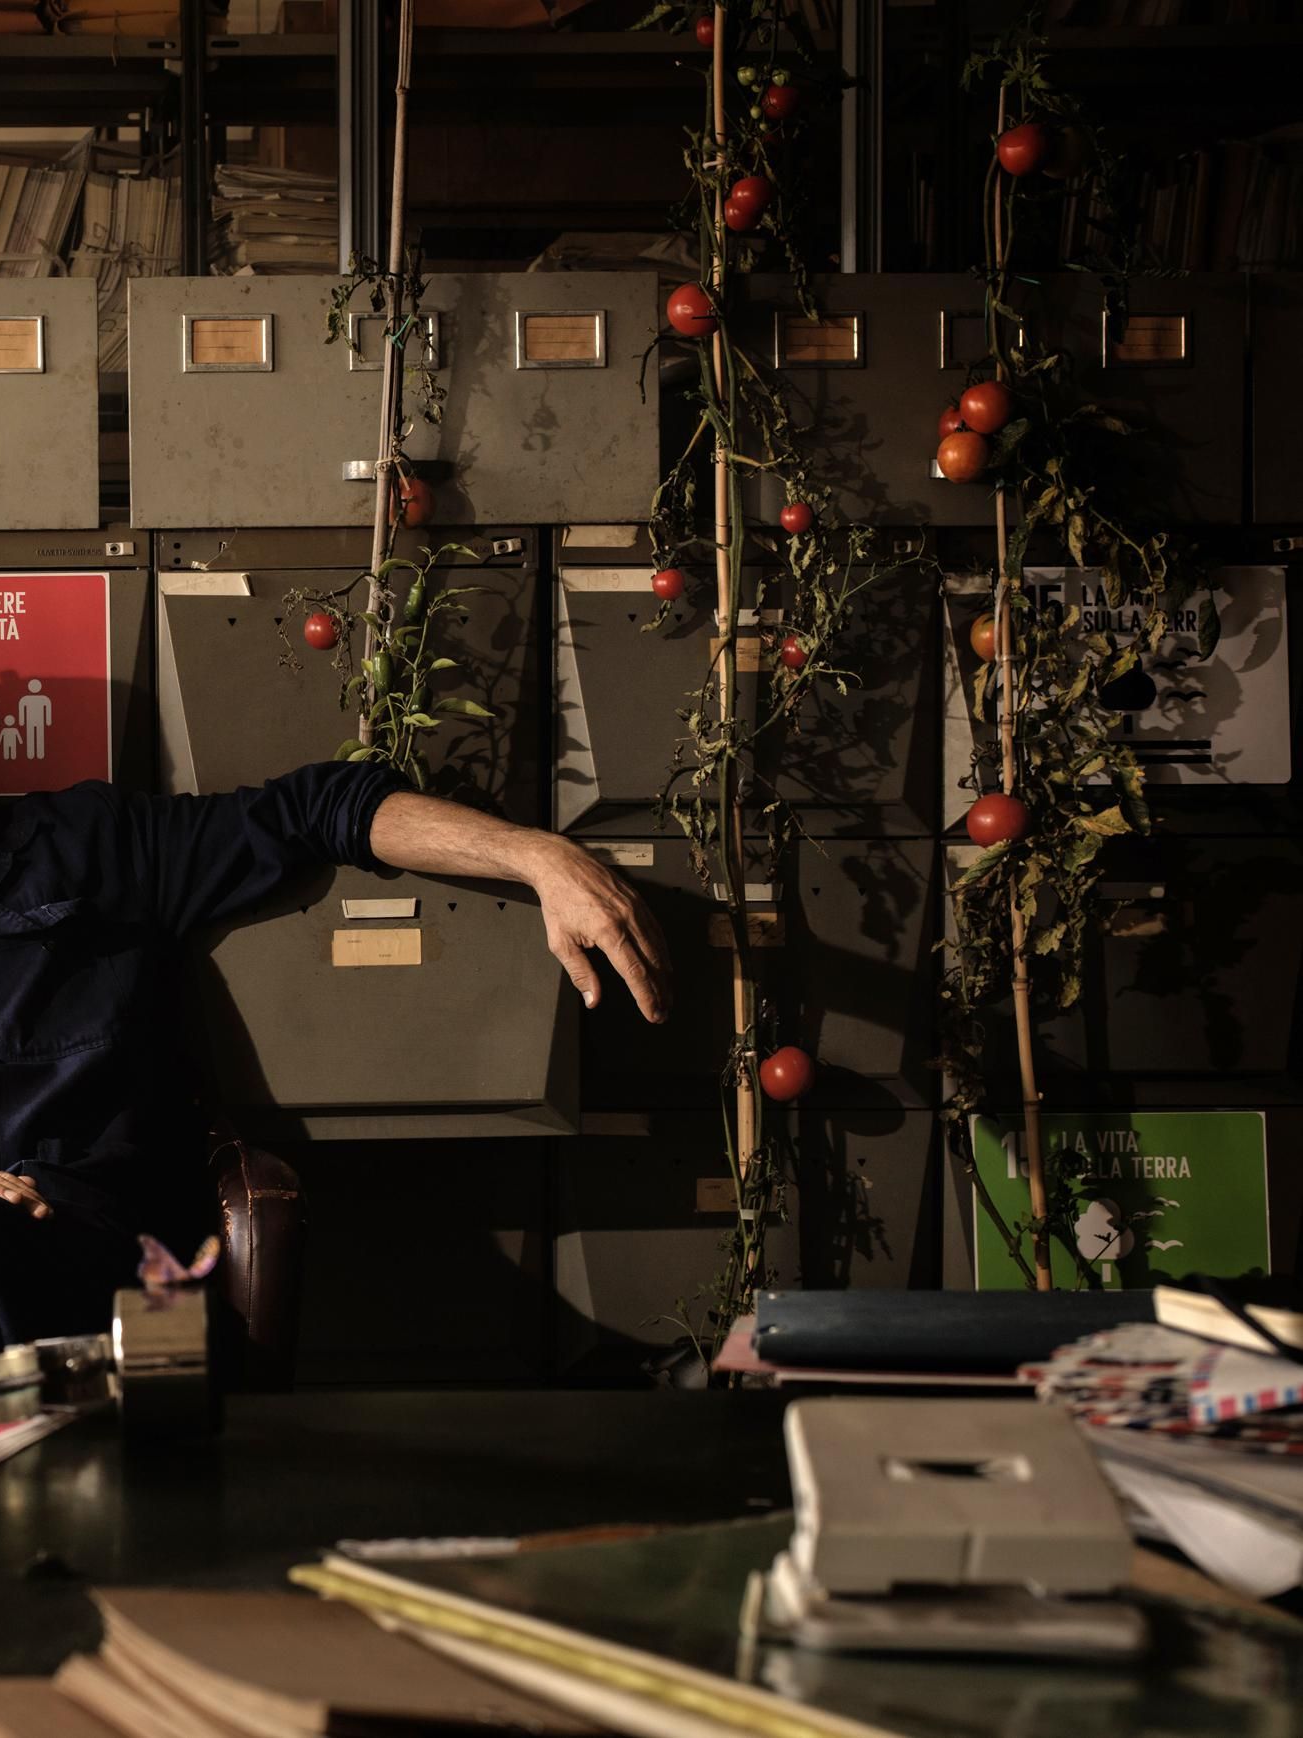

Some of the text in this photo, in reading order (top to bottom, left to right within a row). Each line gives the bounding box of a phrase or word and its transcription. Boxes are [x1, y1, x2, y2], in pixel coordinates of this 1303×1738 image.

[1083, 610, 1142, 632] SULLA
[1096, 1131, 1139, 1153] VITA
[1130, 1156, 1191, 1179] TERRA
